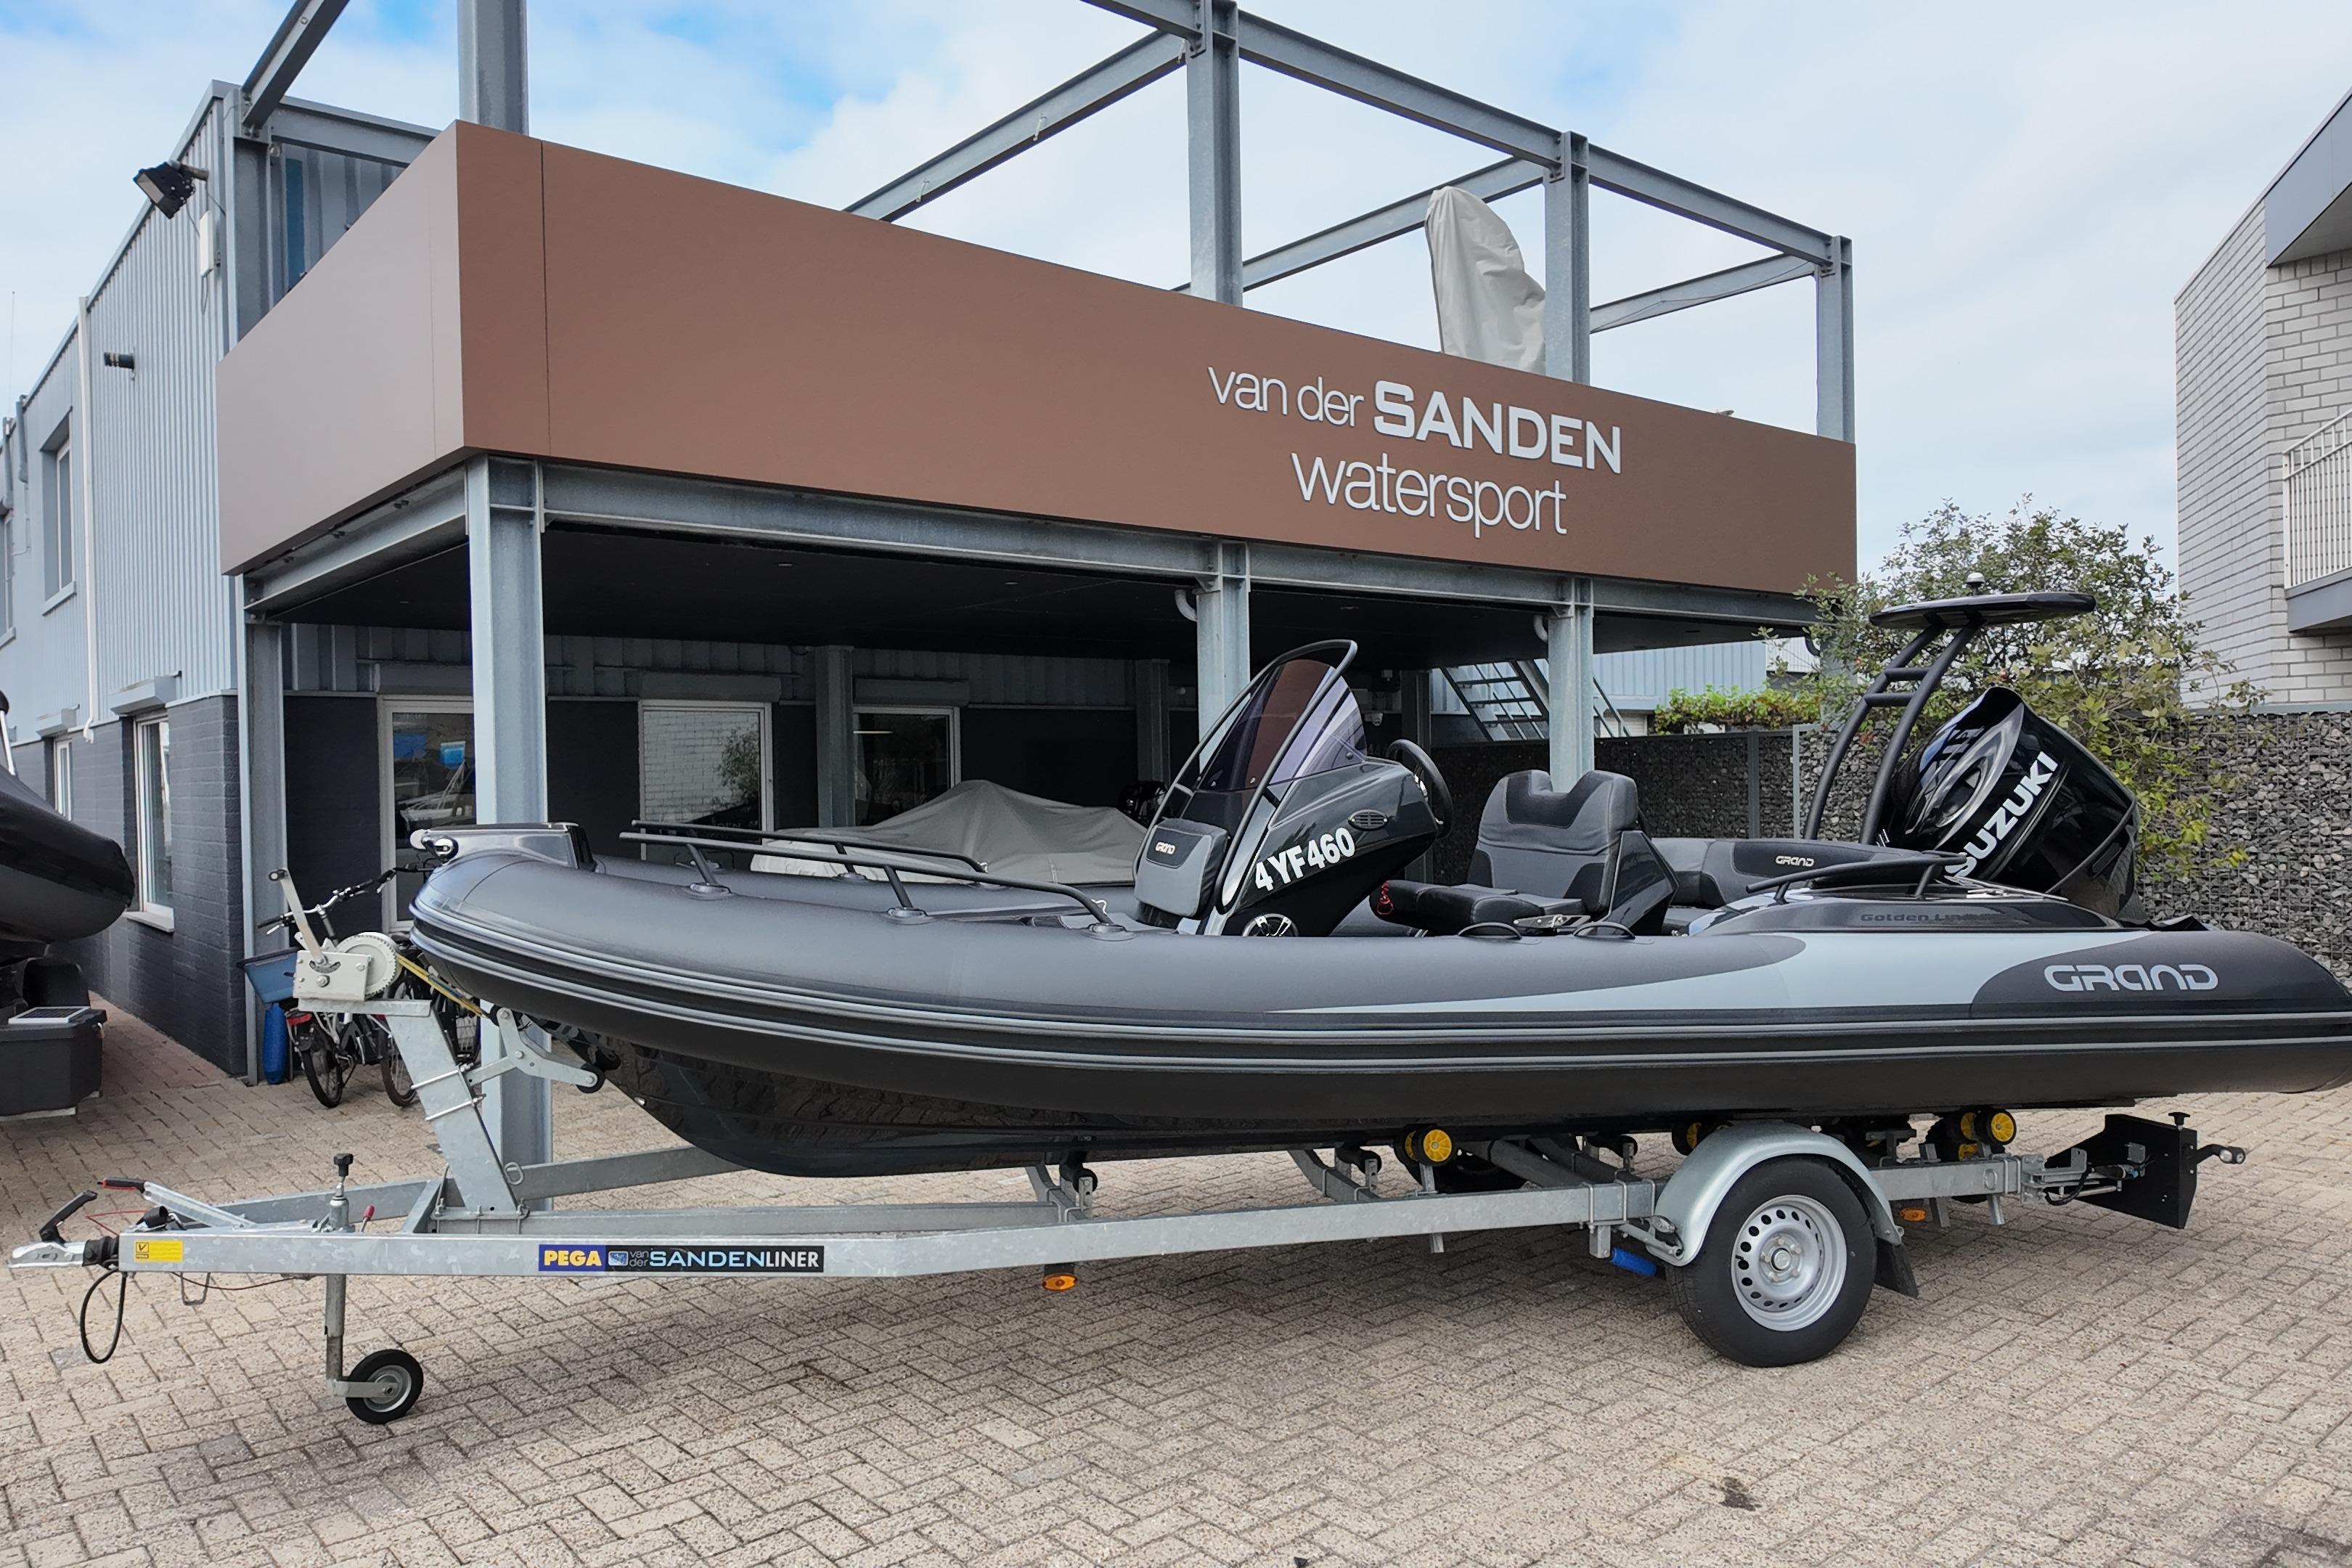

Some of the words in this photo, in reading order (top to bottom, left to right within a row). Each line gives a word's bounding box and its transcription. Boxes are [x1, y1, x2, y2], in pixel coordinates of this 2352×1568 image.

[1208, 366, 1288, 415] van
[1297, 375, 1365, 428] der
[1373, 379, 1622, 475] SANDEN
[1291, 452, 1568, 539] watersport
[1943, 750, 2059, 878] SUZUKI
[1775, 855, 1815, 867] GRAND
[1861, 913, 1929, 922] Golden
[2043, 964, 2218, 992] GRAND
[544, 1249, 603, 1267] PEGA
[629, 1257, 649, 1267] der
